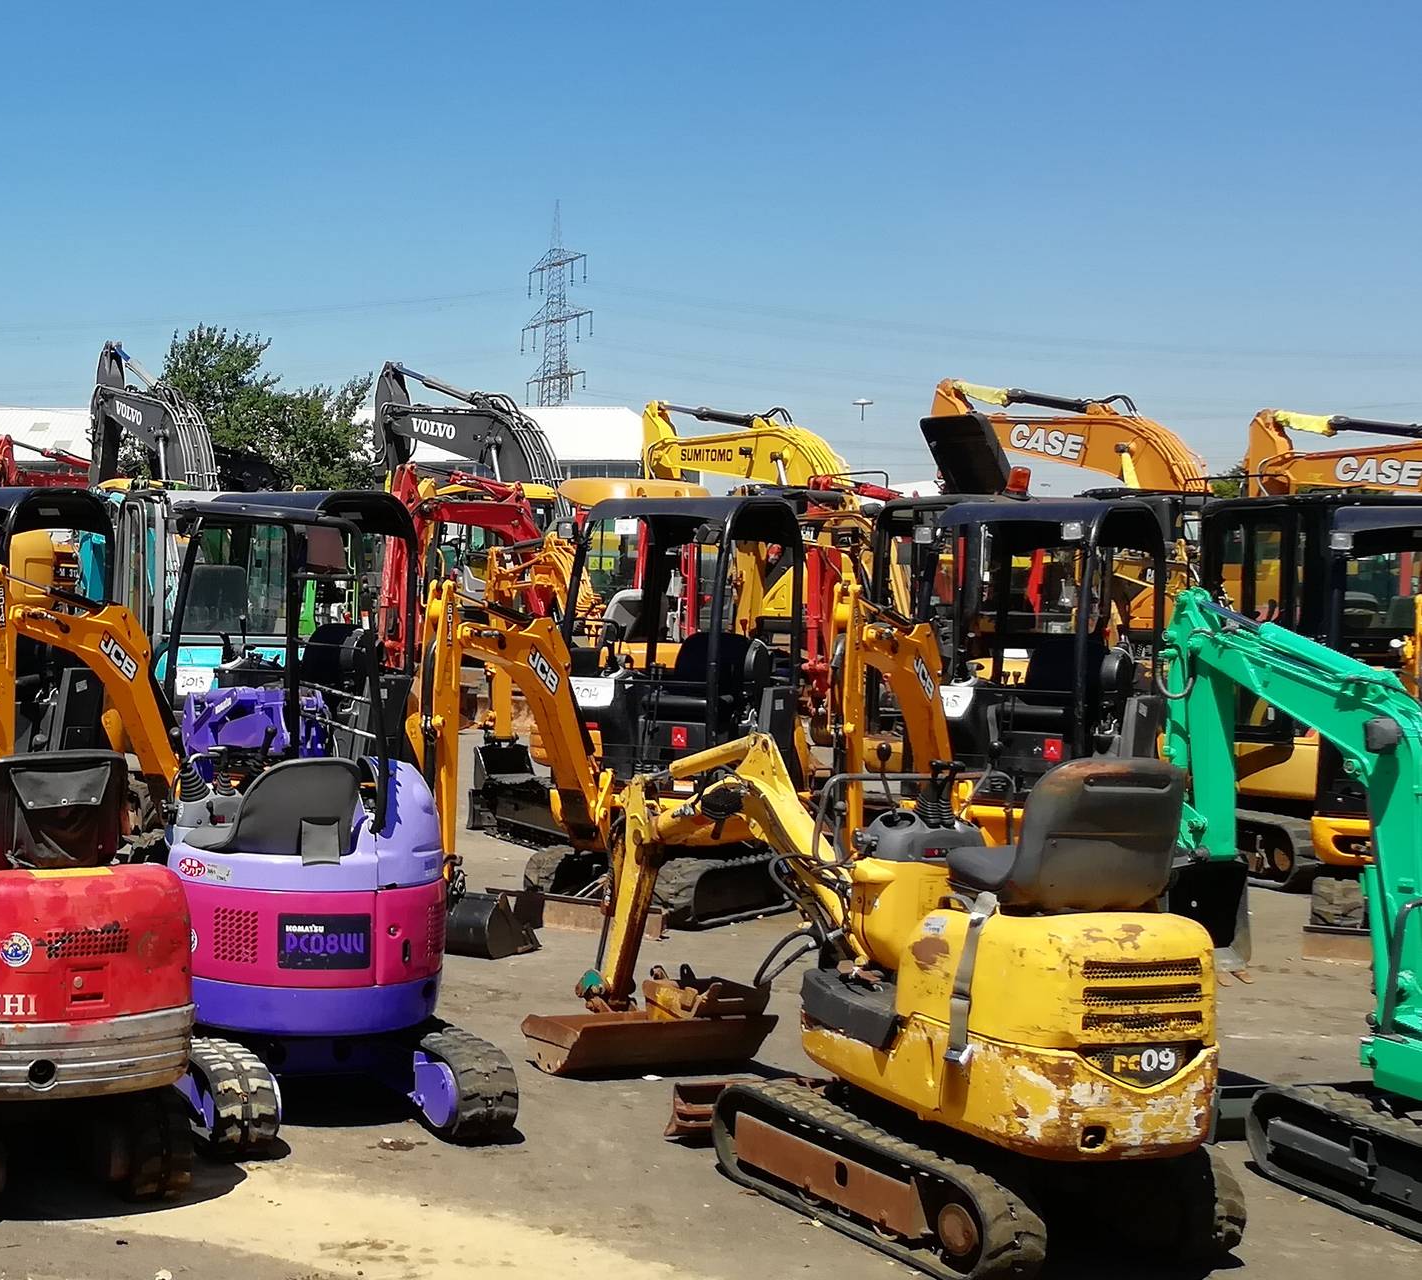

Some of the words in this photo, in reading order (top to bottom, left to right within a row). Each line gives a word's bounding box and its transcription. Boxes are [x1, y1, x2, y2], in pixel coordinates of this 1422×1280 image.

[115, 400, 142, 425] VOLVO
[411, 417, 456, 439] VOLVO
[1010, 424, 1084, 459] CASE
[680, 448, 733, 462] SUMITOMO
[1335, 456, 1422, 486] CASE
[100, 639, 138, 680] JCB
[529, 651, 559, 693] JCB
[285, 924, 324, 933] KOMATSU
